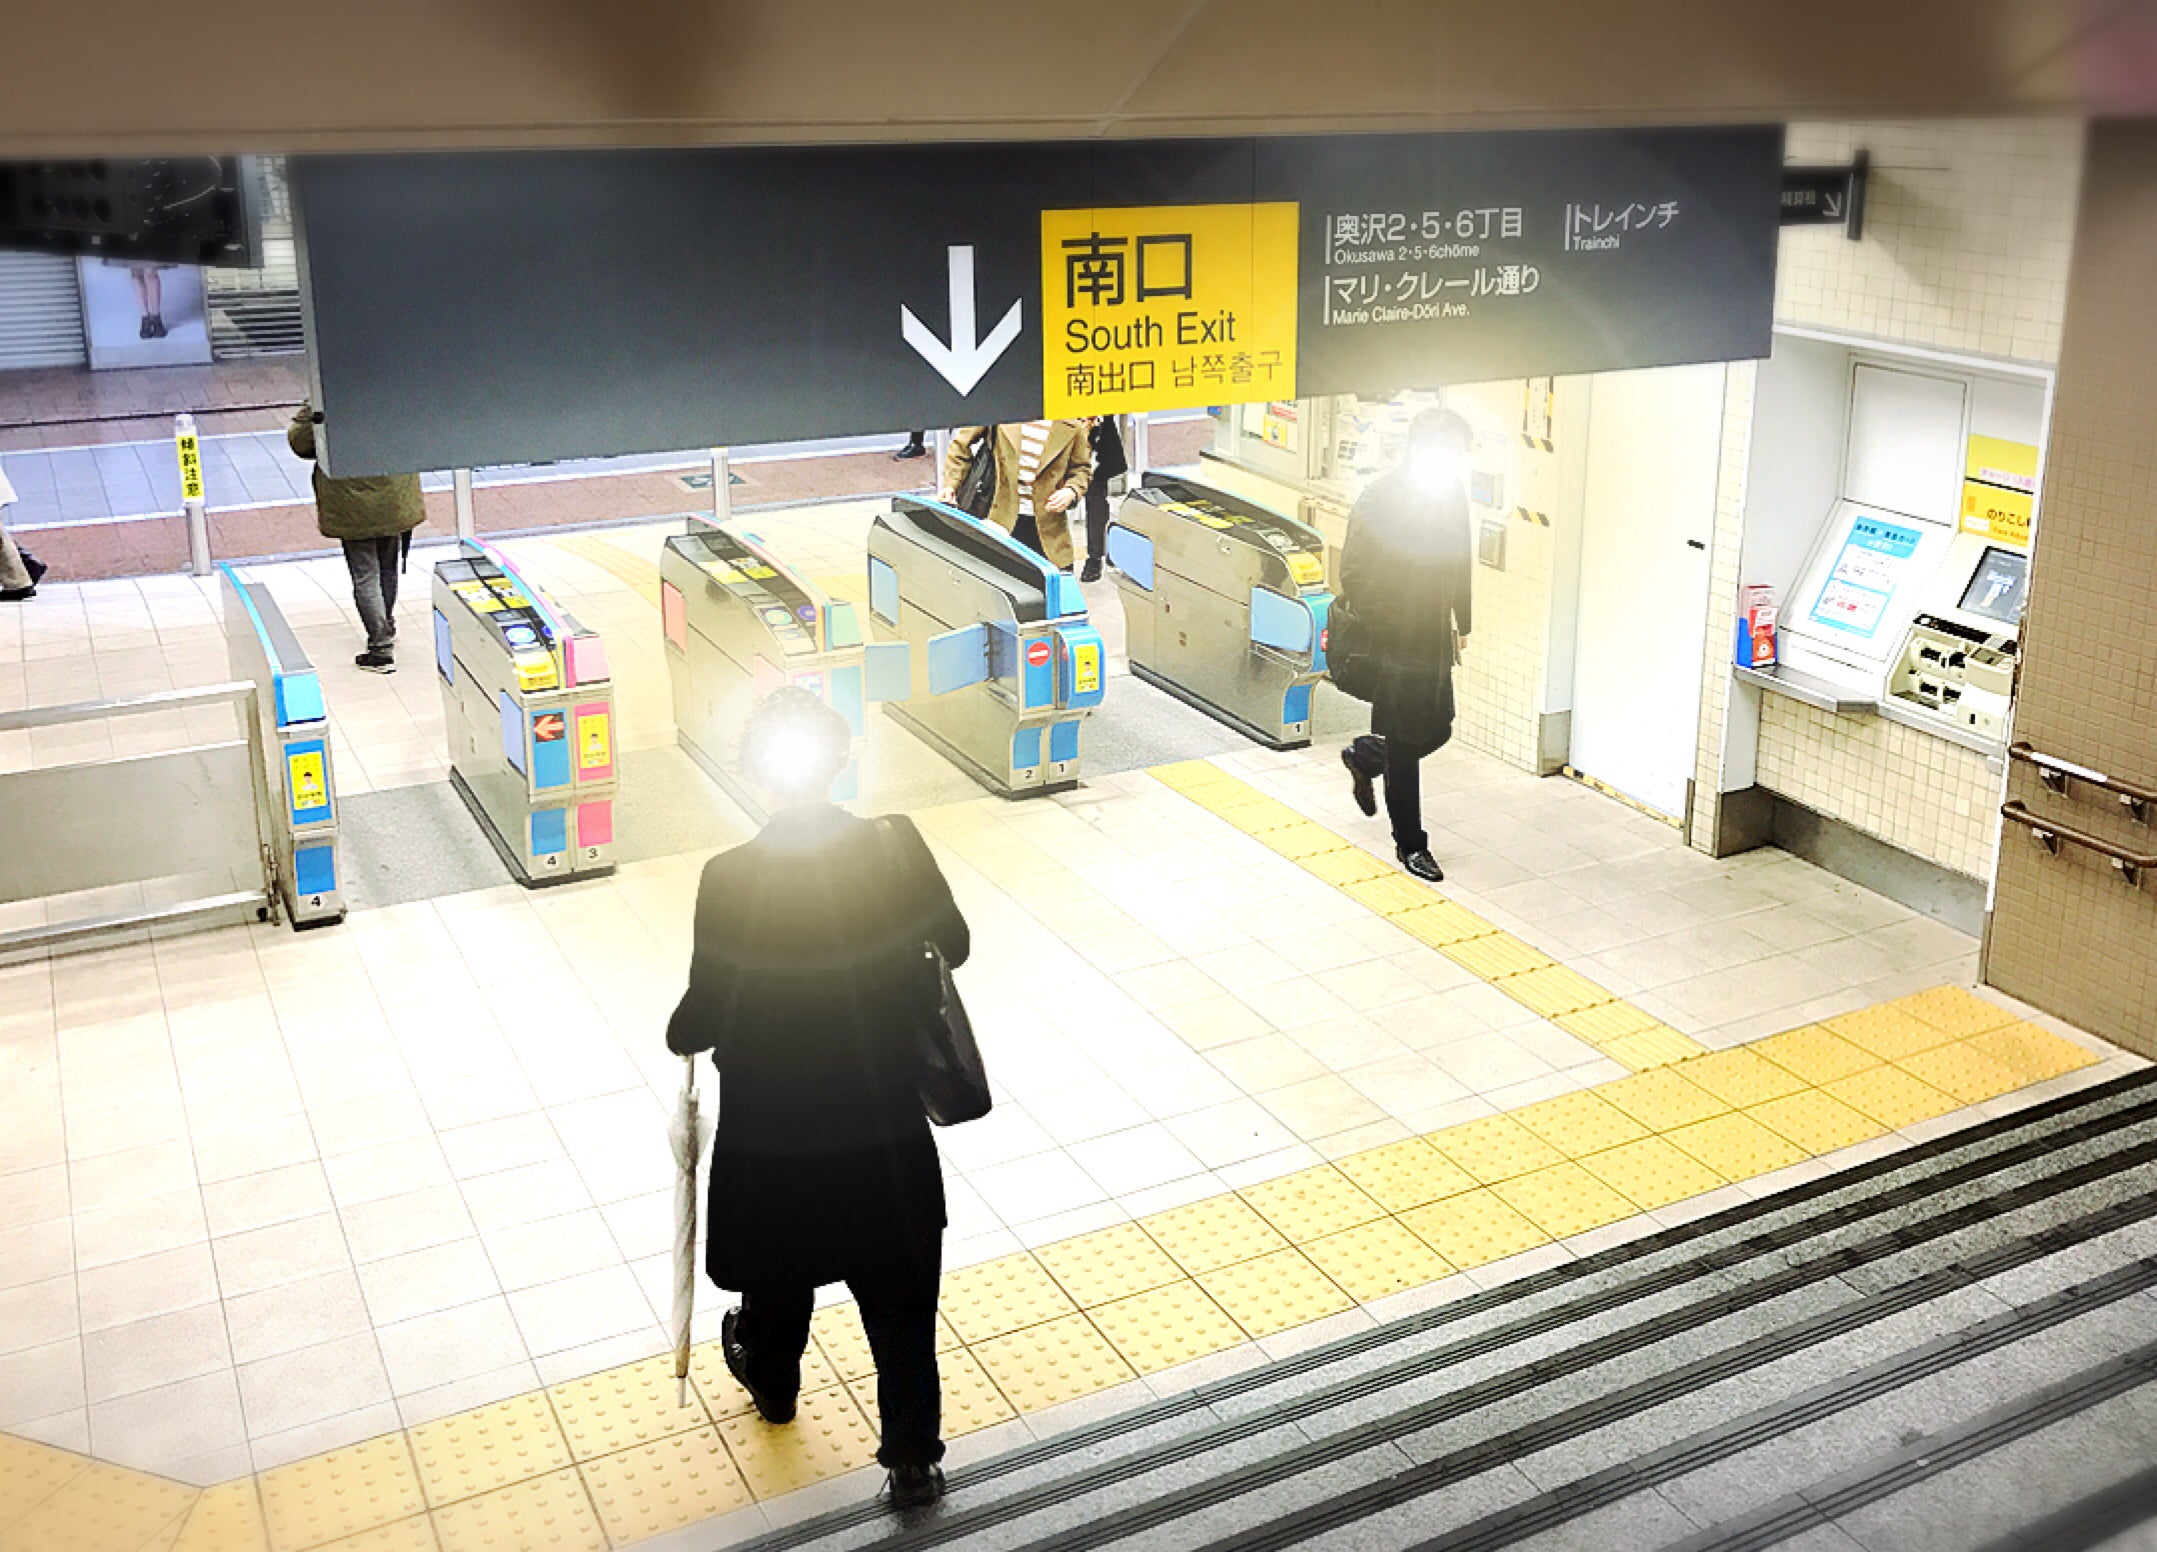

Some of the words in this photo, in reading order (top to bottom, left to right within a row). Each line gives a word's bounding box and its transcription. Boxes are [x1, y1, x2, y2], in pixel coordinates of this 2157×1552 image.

[1333, 207, 1523, 247] 奥沢2・5・6丁目
[1574, 201, 1680, 233] トレインチ
[1573, 234, 1620, 250] Trainchi
[1333, 248, 1396, 265] Okusawa
[1061, 231, 1193, 309] 南口
[1332, 264, 1541, 305] マリ・クレール通り
[1332, 308, 1370, 326] Marie
[1442, 303, 1471, 318] Ave.
[1065, 315, 1163, 353] South
[1176, 309, 1237, 345] Exit
[1065, 360, 1155, 397] 南出口
[1171, 350, 1283, 389] 남쪽출구
[1295, 723, 1301, 733] 1
[1024, 769, 1033, 779] 2
[1058, 763, 1065, 773] 1
[547, 855, 557, 867] 4
[310, 894, 322, 908] 4
